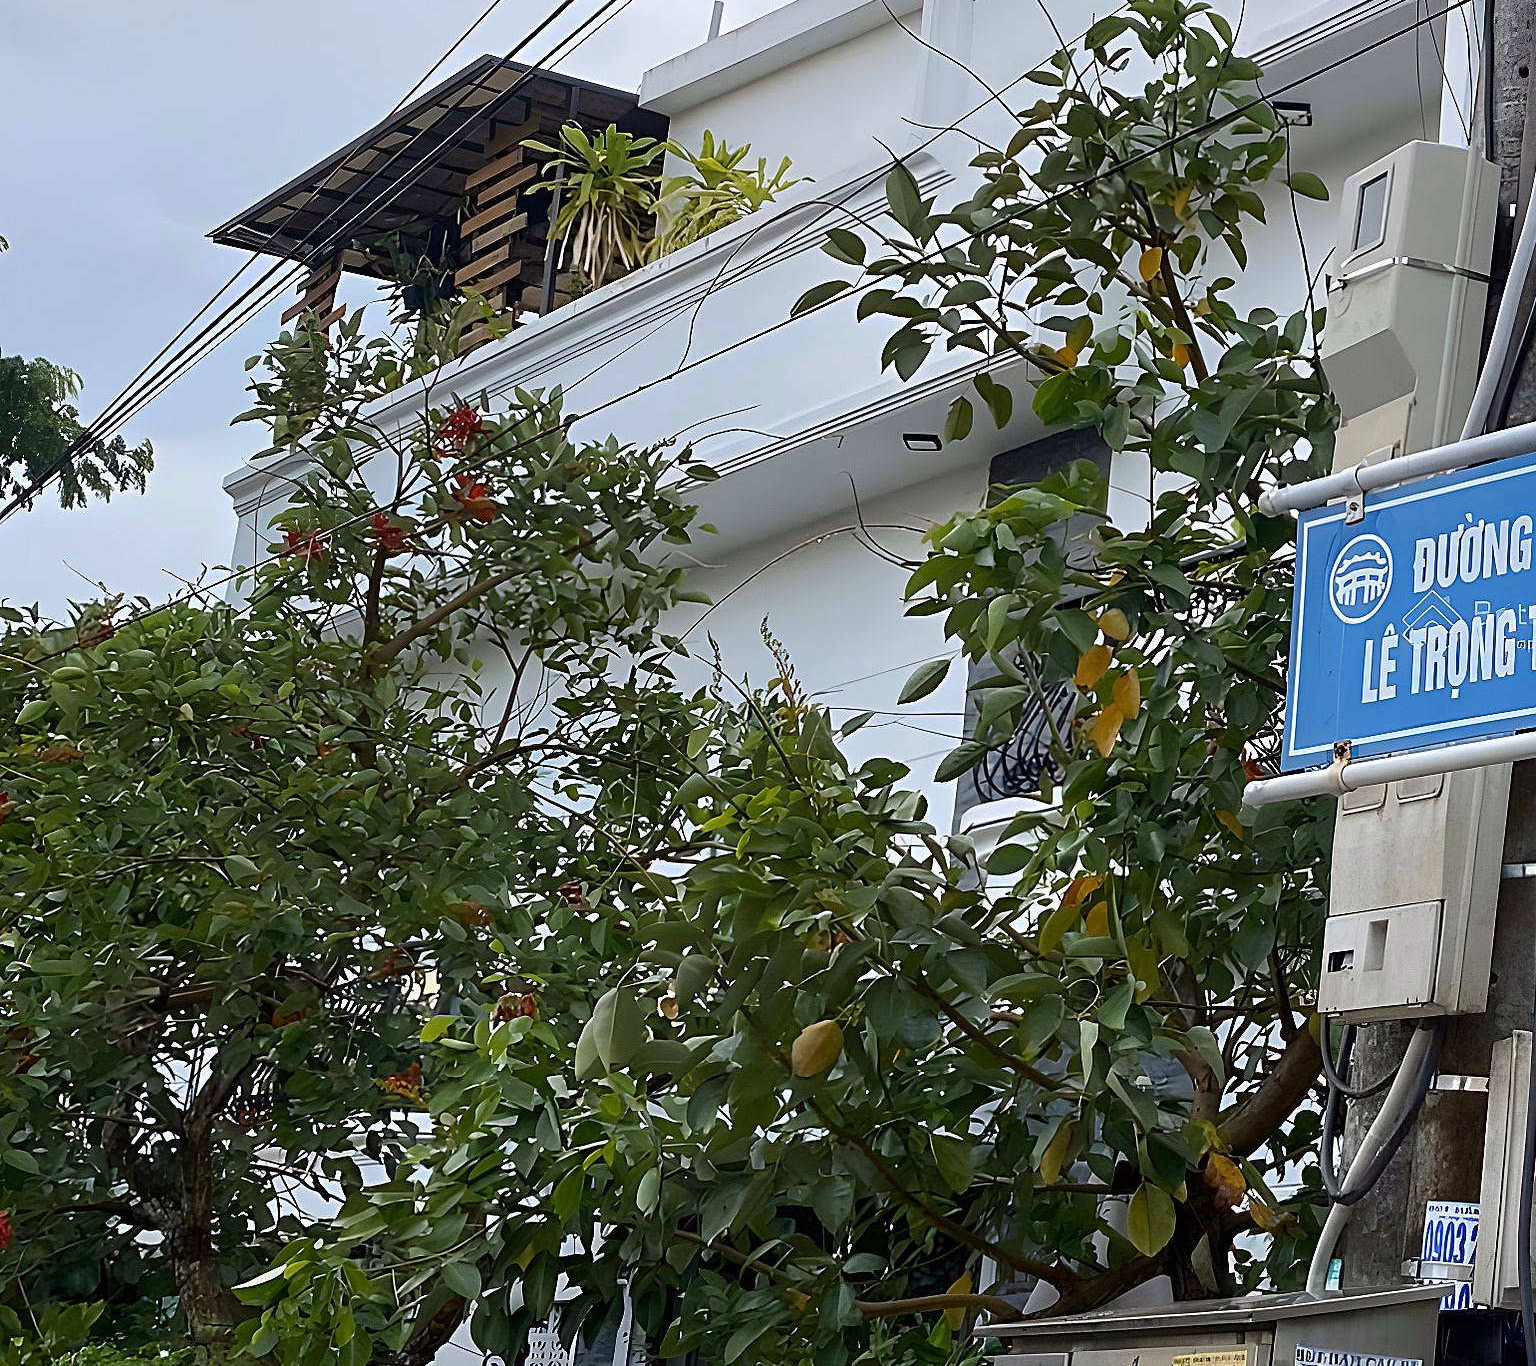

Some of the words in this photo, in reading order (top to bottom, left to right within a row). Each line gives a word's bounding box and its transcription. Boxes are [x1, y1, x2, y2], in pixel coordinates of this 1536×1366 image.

[1413, 512, 1534, 594] ĐƯỜNG
[1360, 622, 1399, 704] LÊ
[1409, 605, 1517, 699] TRỌNG
